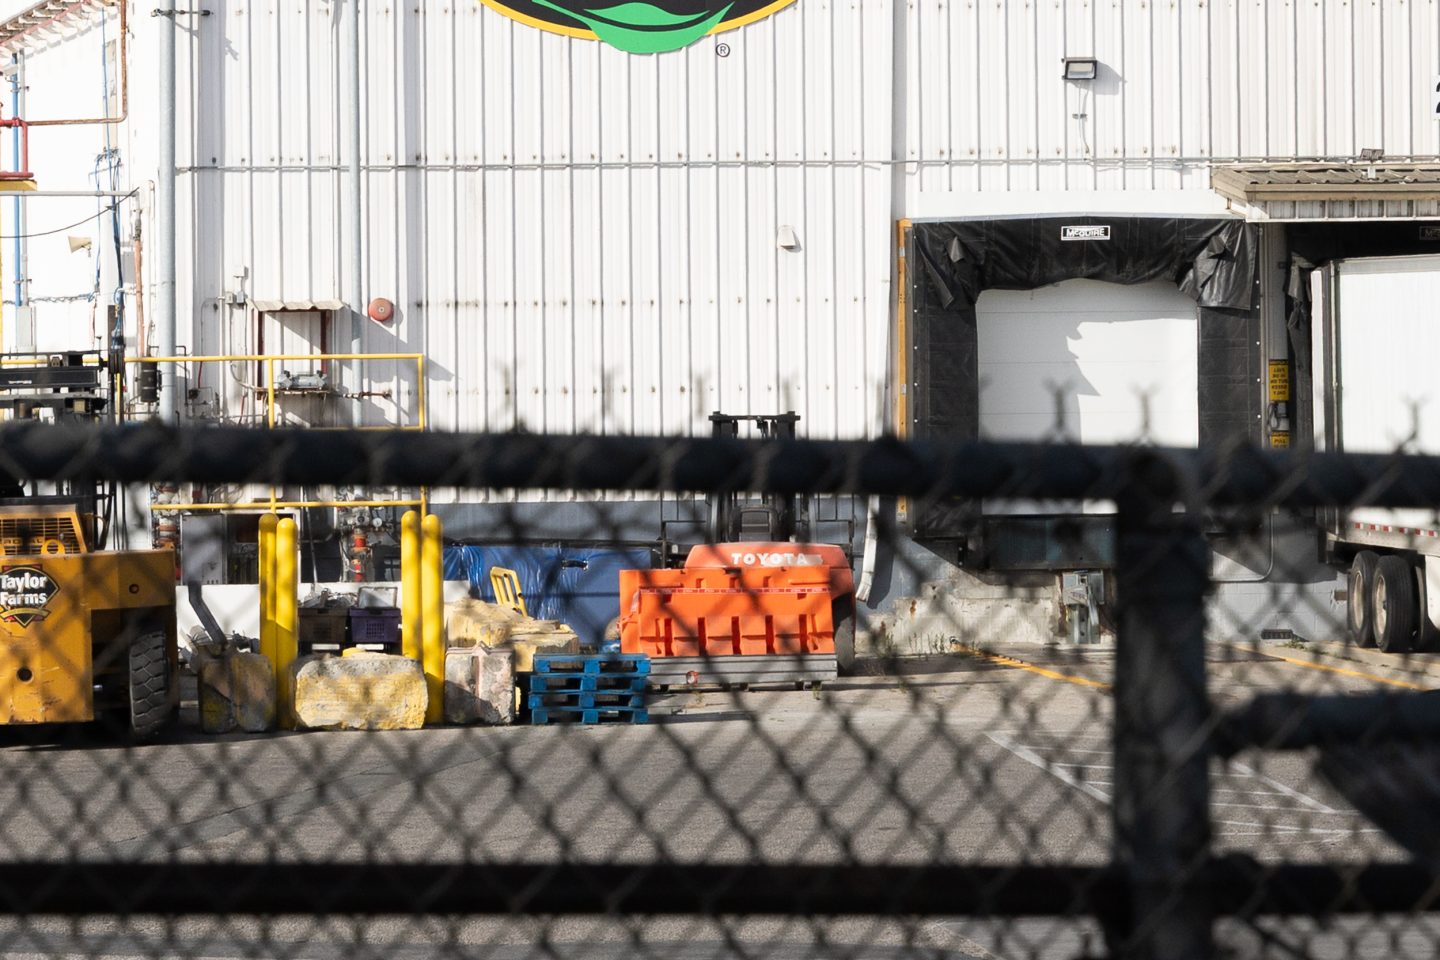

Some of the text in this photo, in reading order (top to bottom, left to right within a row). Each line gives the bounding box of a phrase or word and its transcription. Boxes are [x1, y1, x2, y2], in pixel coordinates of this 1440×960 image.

[731, 553, 808, 565] TOYOTA
[0, 572, 47, 593] Taylor
[0, 591, 47, 605] Farms
